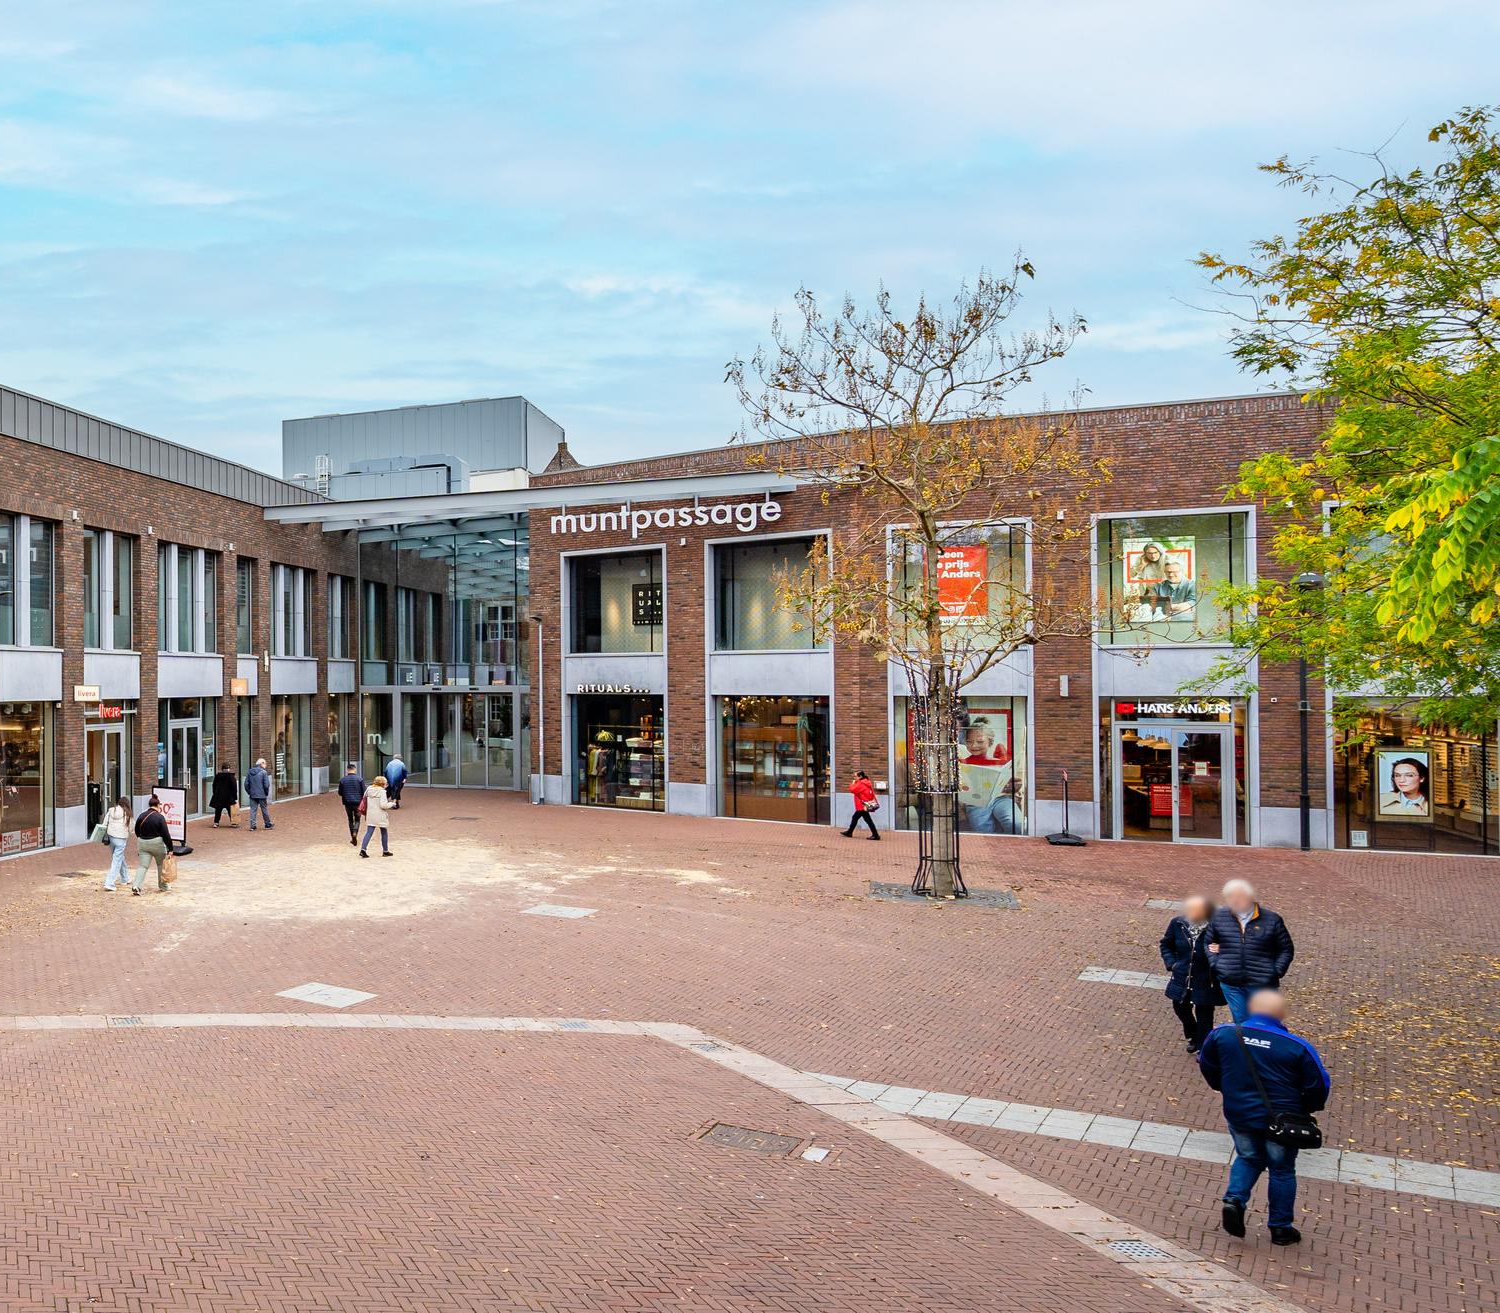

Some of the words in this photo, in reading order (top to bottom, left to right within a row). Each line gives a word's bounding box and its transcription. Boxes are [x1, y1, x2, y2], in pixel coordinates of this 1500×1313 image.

[551, 501, 782, 539] muntpassage
[945, 560, 969, 570] prijs
[941, 570, 981, 578] Anders
[99, 704, 122, 718] livera
[1138, 703, 1174, 713] HANS
[1178, 703, 1232, 713] ANDERS
